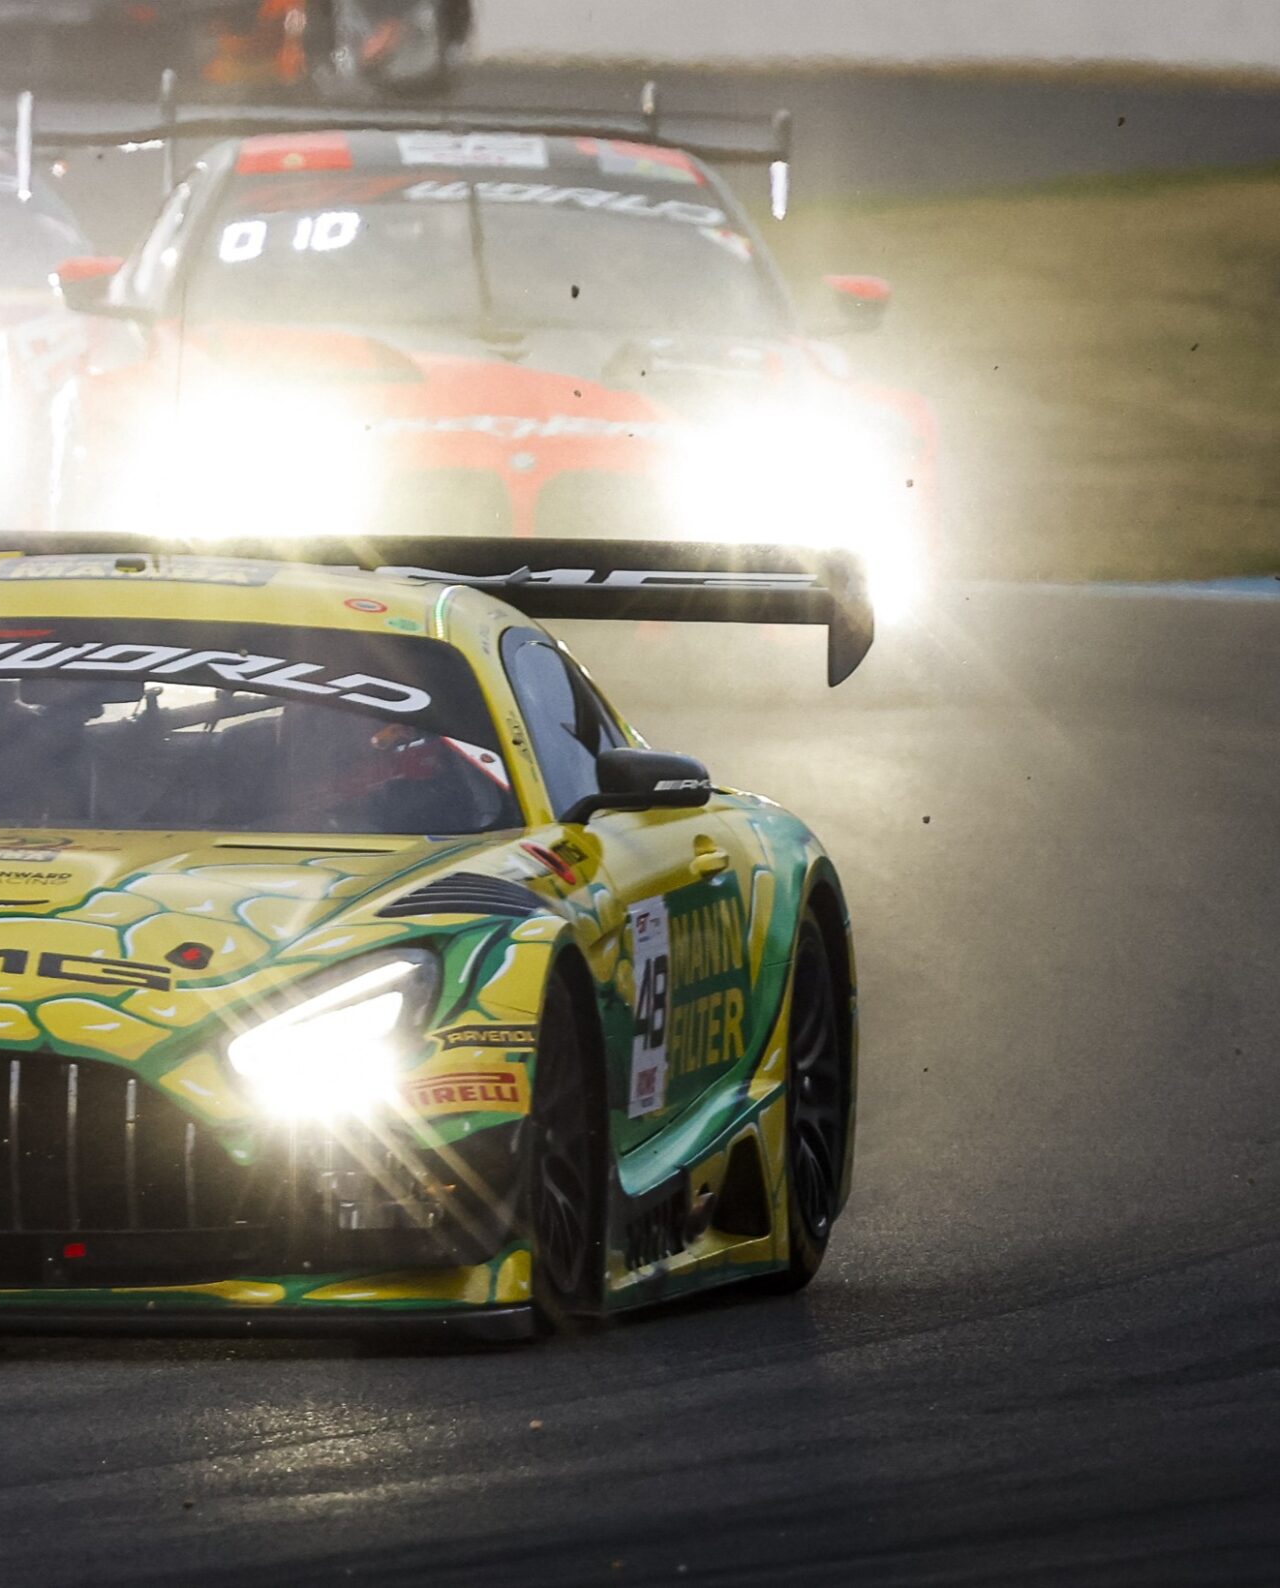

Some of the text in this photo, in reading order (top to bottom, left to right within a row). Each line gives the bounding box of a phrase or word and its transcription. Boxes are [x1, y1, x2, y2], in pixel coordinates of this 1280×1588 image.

[672, 896, 743, 991] MANN
[447, 1030, 537, 1044] RAVENOL
[634, 954, 668, 1051] 48
[670, 986, 747, 1080] FILTER
